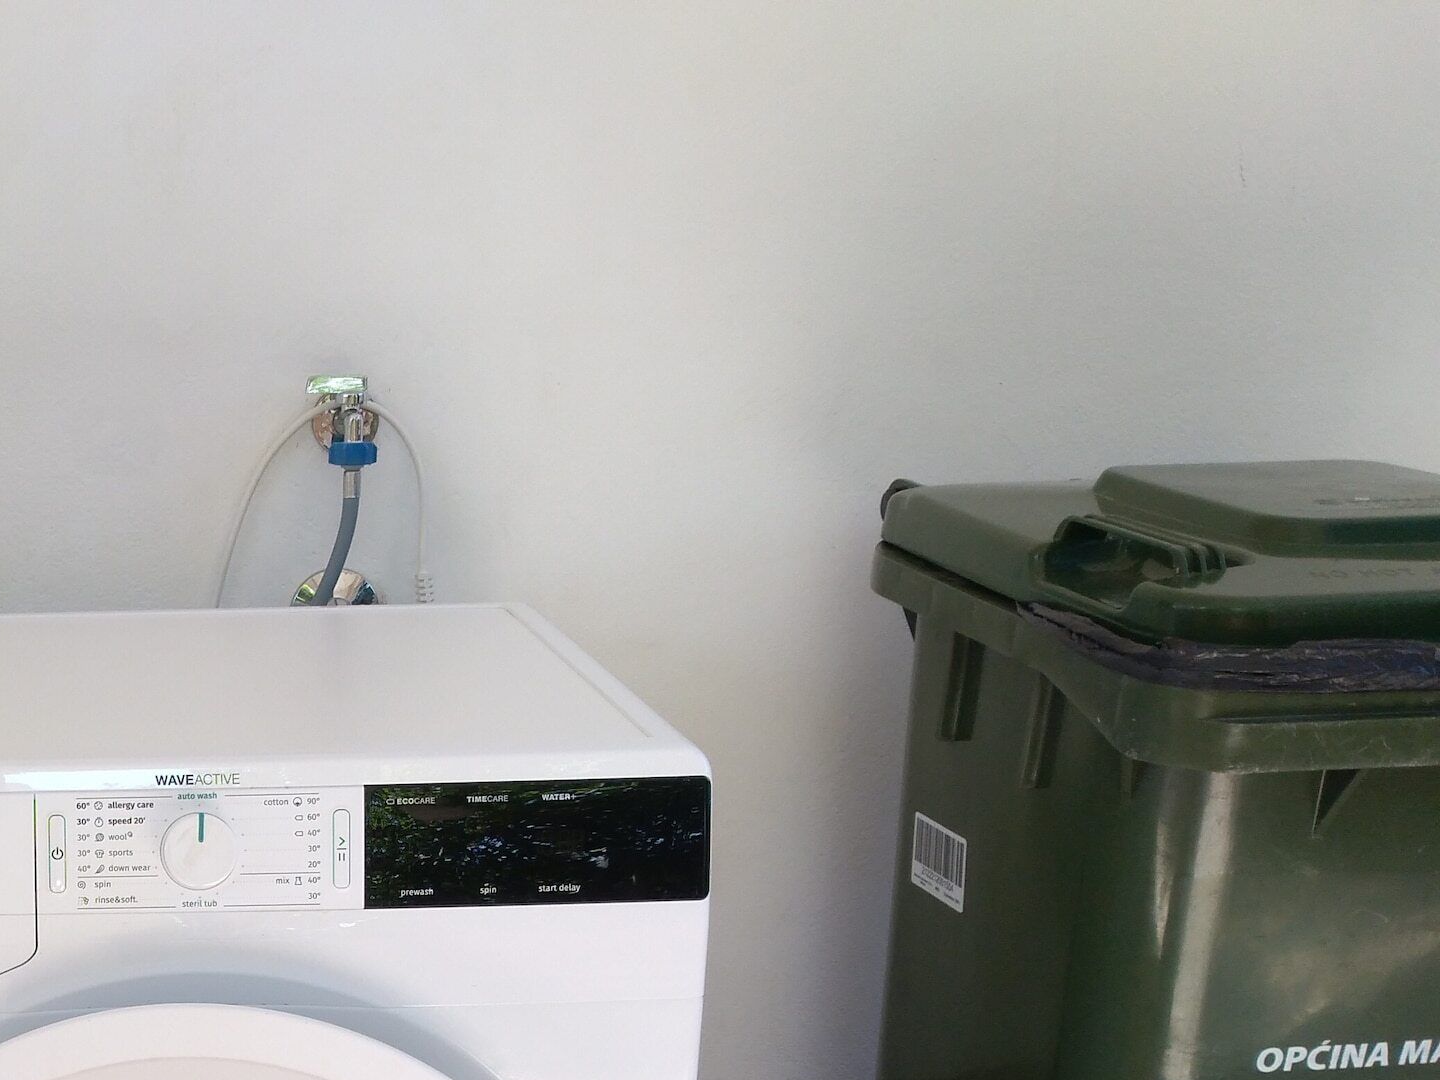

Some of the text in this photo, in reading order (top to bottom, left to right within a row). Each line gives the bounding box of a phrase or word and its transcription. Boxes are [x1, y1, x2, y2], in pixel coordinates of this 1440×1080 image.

[155, 773, 240, 786] WAVEACTIVE
[196, 792, 217, 800] wash
[542, 793, 577, 801] WATER+
[108, 801, 134, 810] allergy
[109, 849, 133, 857] sports
[94, 880, 111, 888] spin
[538, 883, 581, 893] start delay
[400, 887, 434, 897] prewash
[480, 885, 497, 895] spin
[203, 899, 218, 907] tub
[1256, 1039, 1389, 1073] OPĆINA
